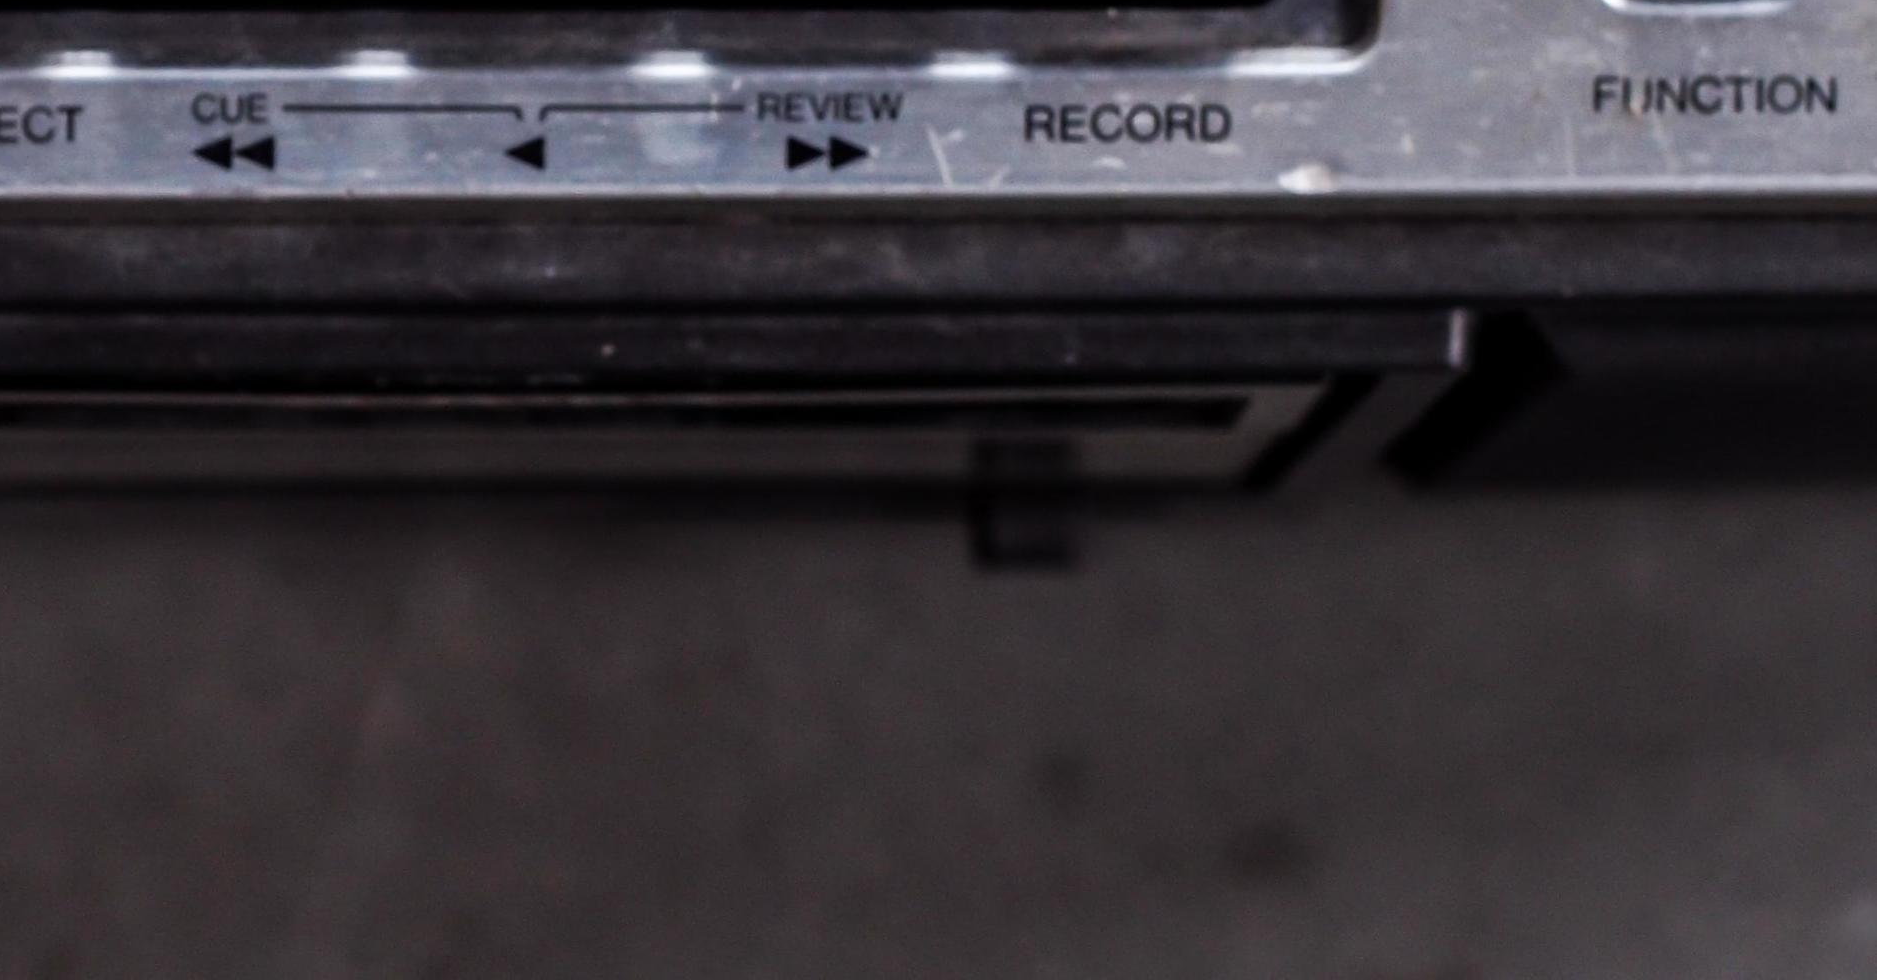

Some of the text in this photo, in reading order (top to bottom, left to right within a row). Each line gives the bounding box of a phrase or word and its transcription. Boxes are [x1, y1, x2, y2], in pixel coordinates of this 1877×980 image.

[191, 93, 268, 123] CUE
[758, 92, 904, 122] REVIEW
[1592, 75, 1838, 115] FUNCTION
[1024, 103, 1233, 144] RECORD
